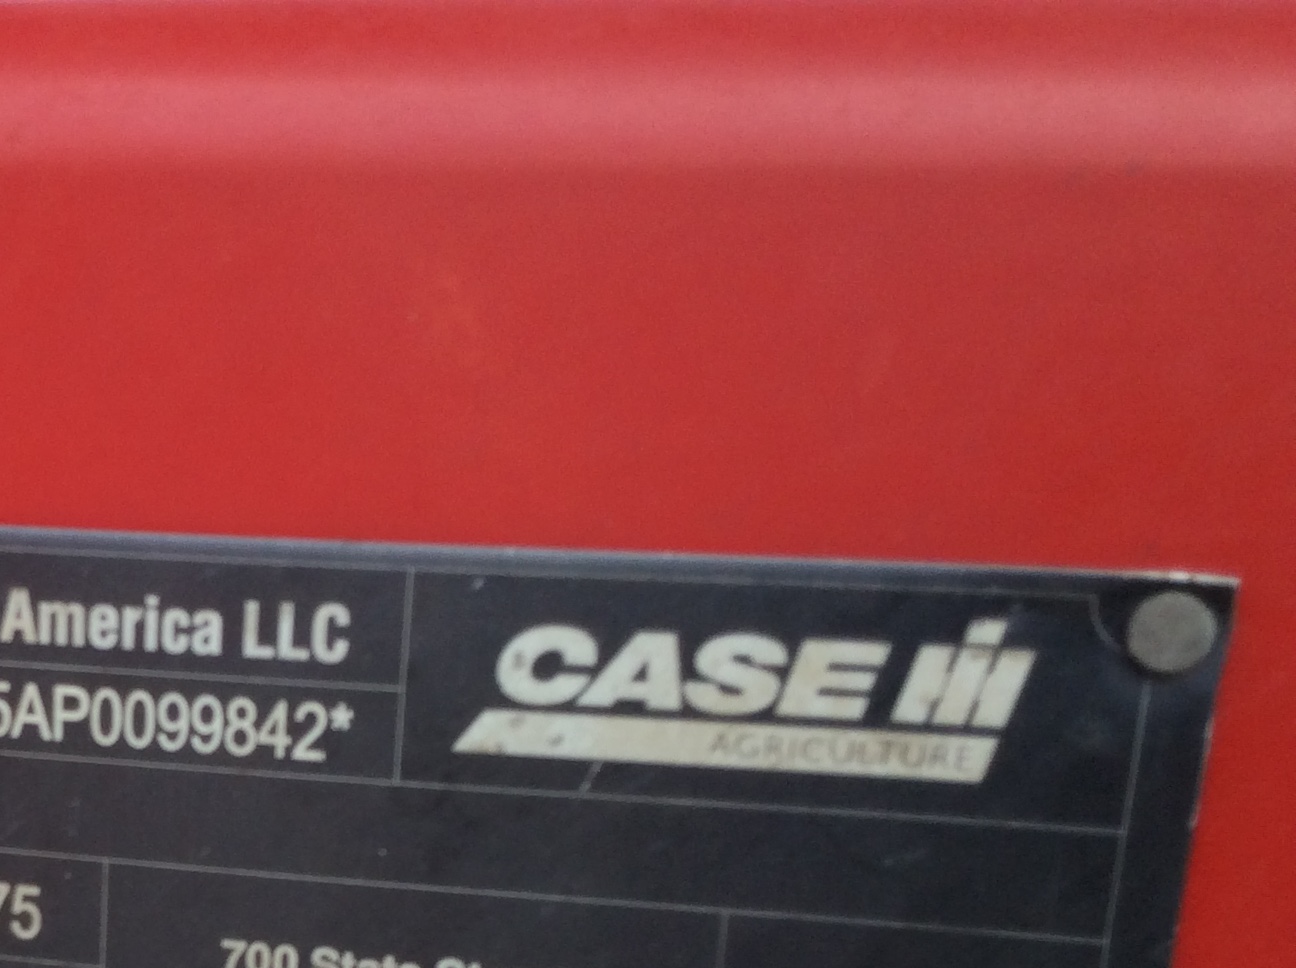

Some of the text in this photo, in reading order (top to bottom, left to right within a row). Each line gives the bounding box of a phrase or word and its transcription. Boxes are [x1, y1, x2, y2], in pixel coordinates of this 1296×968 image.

[0, 585, 225, 657] America
[241, 599, 352, 665] LLC
[495, 624, 892, 722] CASE
[710, 727, 974, 772] AGRICULTURE
